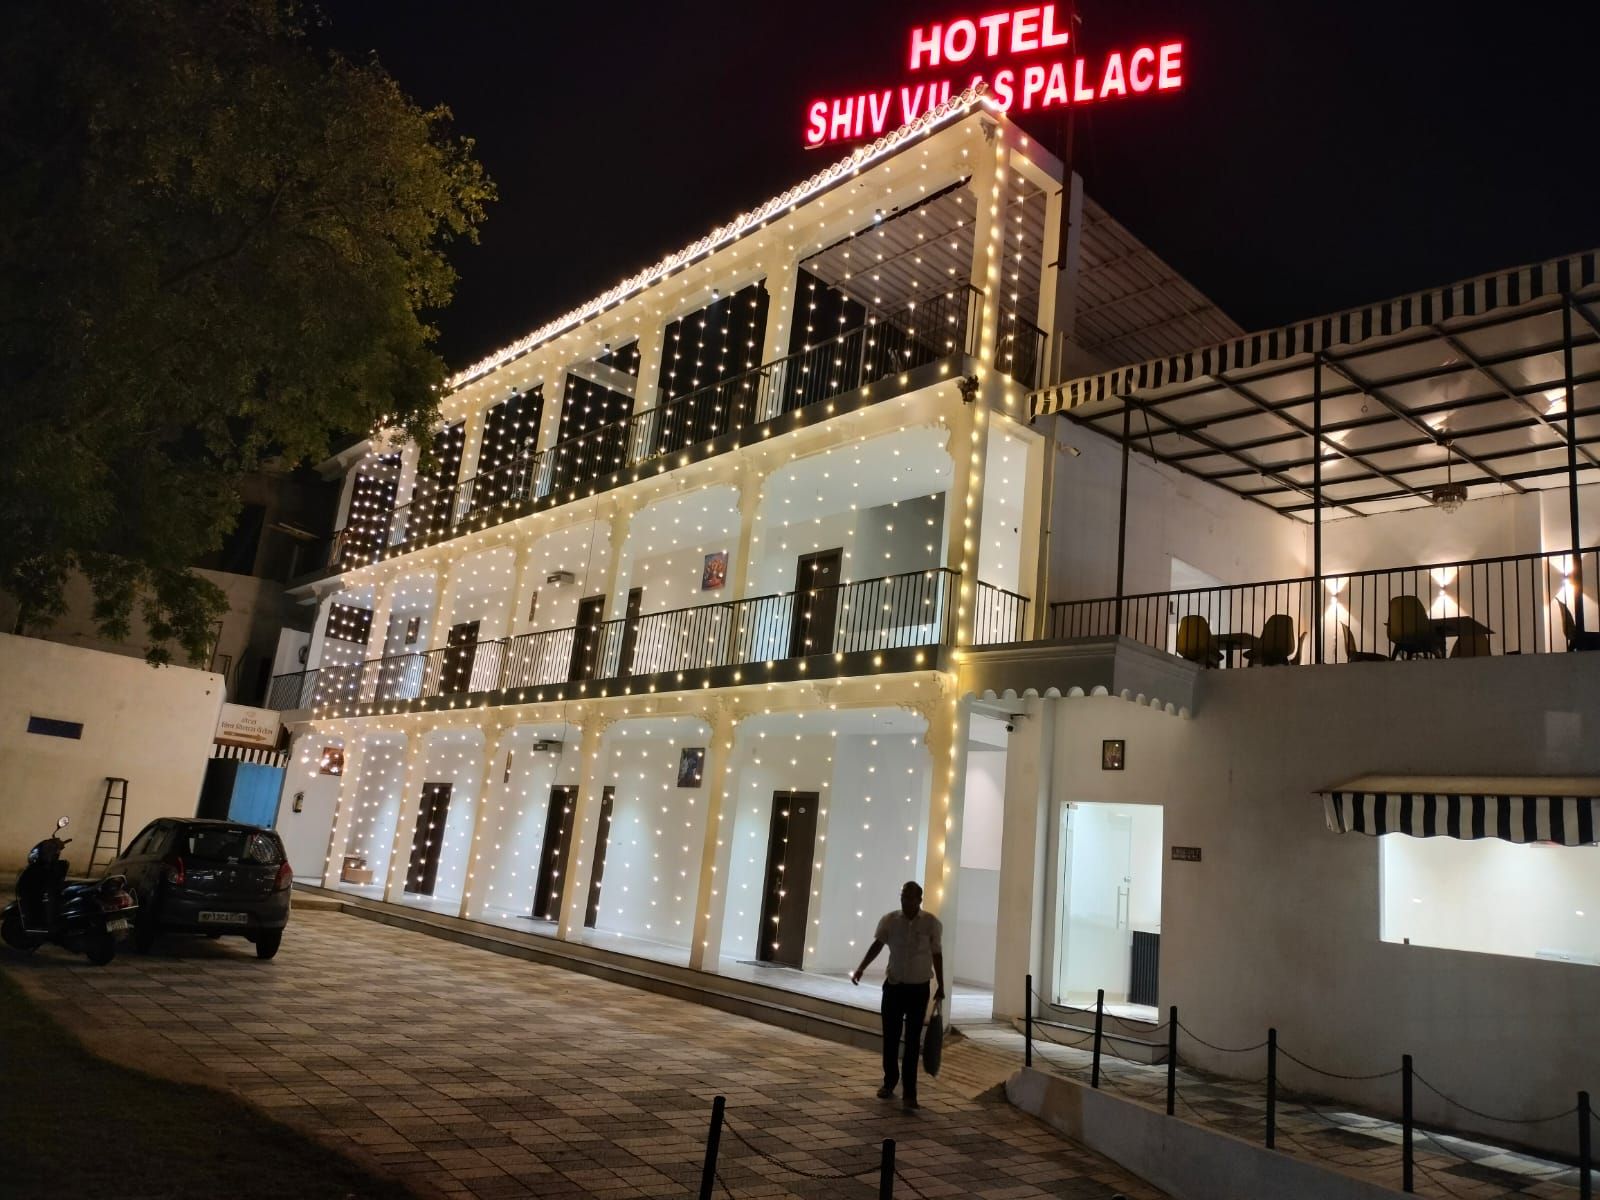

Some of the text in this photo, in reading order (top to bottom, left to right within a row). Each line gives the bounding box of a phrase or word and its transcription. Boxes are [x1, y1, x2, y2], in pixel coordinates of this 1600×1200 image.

[910, 5, 1069, 70] HOTEL
[807, 43, 1183, 143] SHIV VIS PALACE
